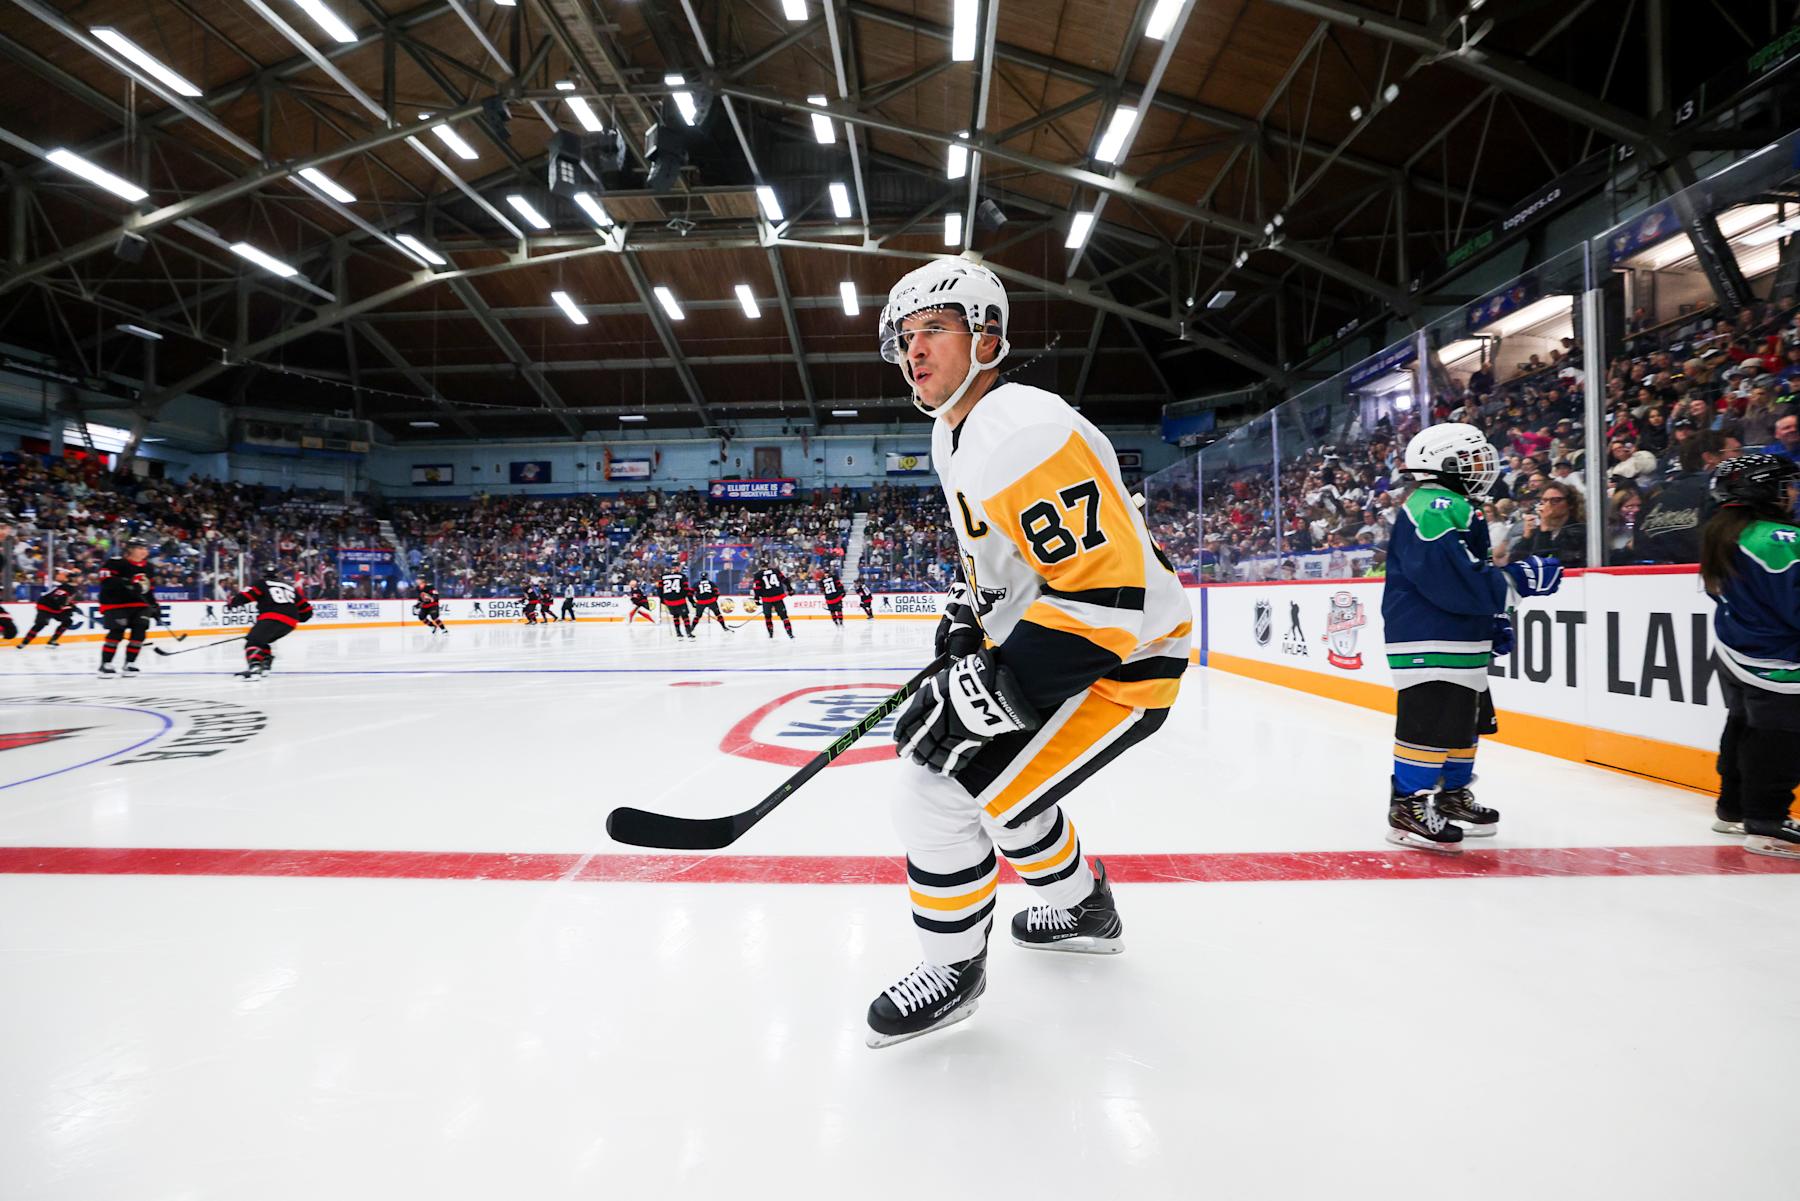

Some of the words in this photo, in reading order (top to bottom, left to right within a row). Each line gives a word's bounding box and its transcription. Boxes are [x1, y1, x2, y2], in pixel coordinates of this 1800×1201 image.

[1676, 100, 1695, 125] 13
[727, 484, 750, 492] ELLIOT
[770, 483, 778, 491] IS
[956, 490, 989, 540] C
[1019, 477, 1109, 566] 87
[663, 579, 681, 594] 24
[699, 583, 712, 593] 12
[763, 574, 780, 590] 14
[825, 581, 837, 595] 21
[895, 595, 928, 604] GOALS
[929, 595, 936, 604] &
[895, 605, 937, 613] DREAMS
[1282, 642, 1309, 657] NHLPA
[995, 690, 1026, 730] PENGUINS
[1052, 933, 1079, 941] CCM
[933, 996, 962, 1018] CCM
